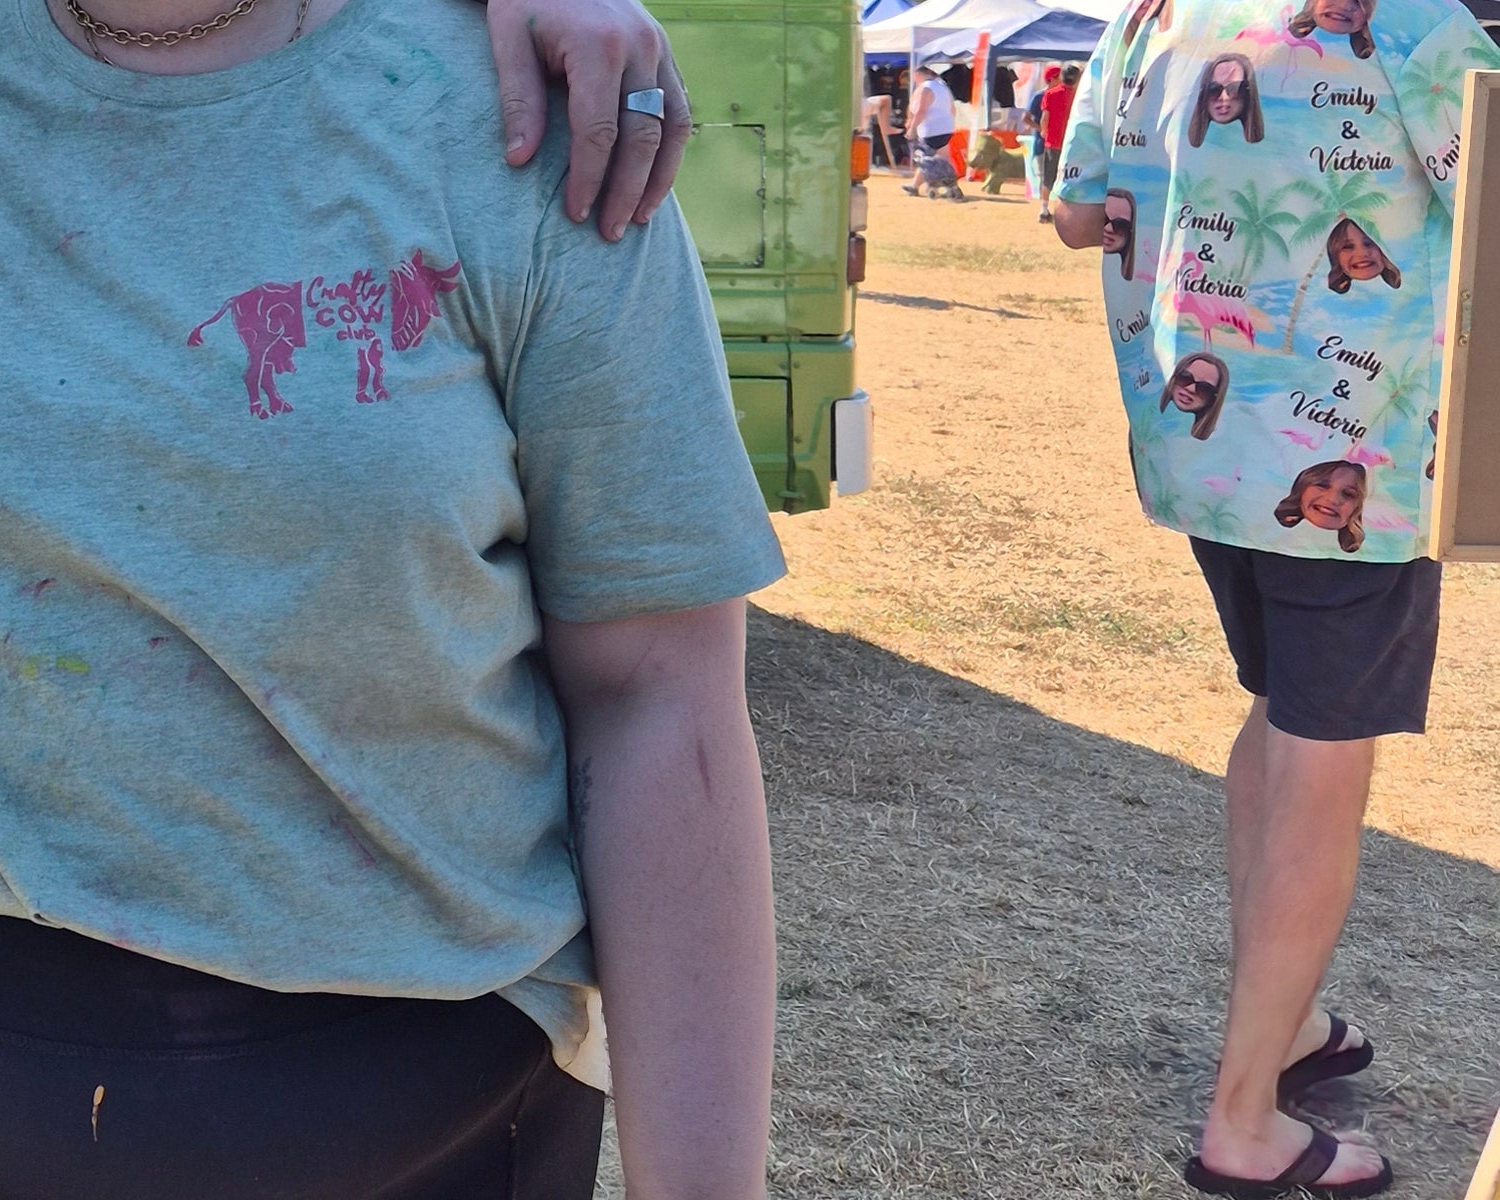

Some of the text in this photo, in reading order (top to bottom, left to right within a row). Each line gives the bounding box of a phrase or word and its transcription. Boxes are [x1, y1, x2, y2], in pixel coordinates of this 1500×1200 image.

[1311, 81, 1378, 115] Emily
[1341, 120, 1360, 140] &
[1309, 145, 1394, 173] Victoria
[1177, 204, 1238, 242] Emily
[1198, 243, 1215, 263] &
[306, 268, 387, 308] Crafty
[1175, 268, 1247, 299] Victoria
[1116, 309, 1150, 343] Emil
[1317, 335, 1385, 382] Emily
[1332, 379, 1351, 400] &
[1290, 390, 1368, 440] Victoria
